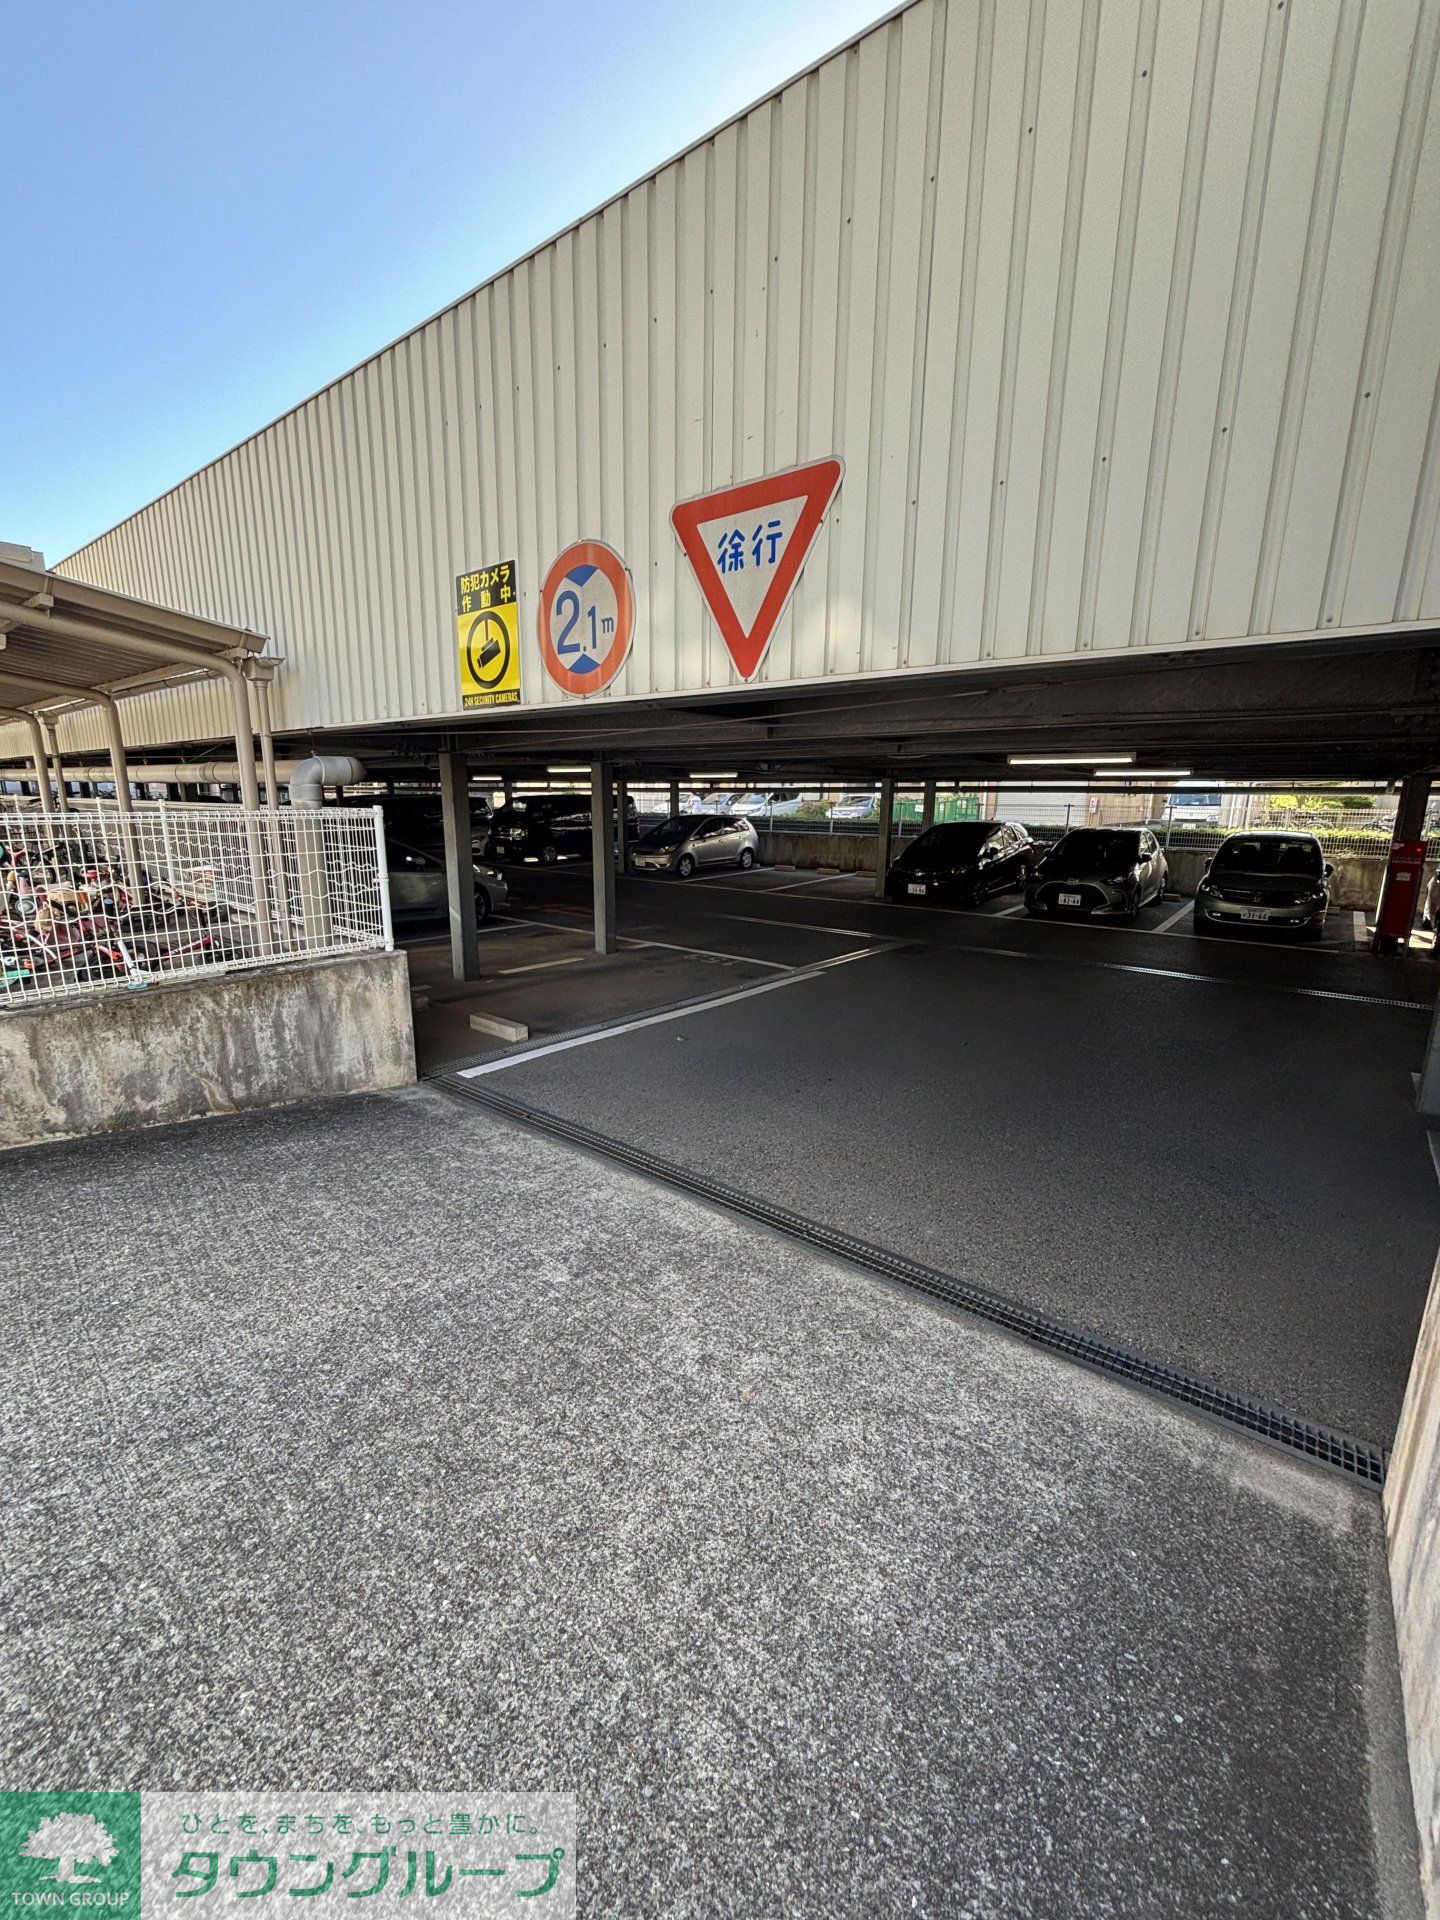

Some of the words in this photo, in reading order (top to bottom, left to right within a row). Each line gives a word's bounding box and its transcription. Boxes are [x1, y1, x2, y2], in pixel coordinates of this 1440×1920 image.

[717, 519, 783, 574] 徐行
[460, 564, 510, 595] 防犯カメラ
[474, 694, 495, 706] SECURITY
[495, 691, 518, 704] CAMERAS
